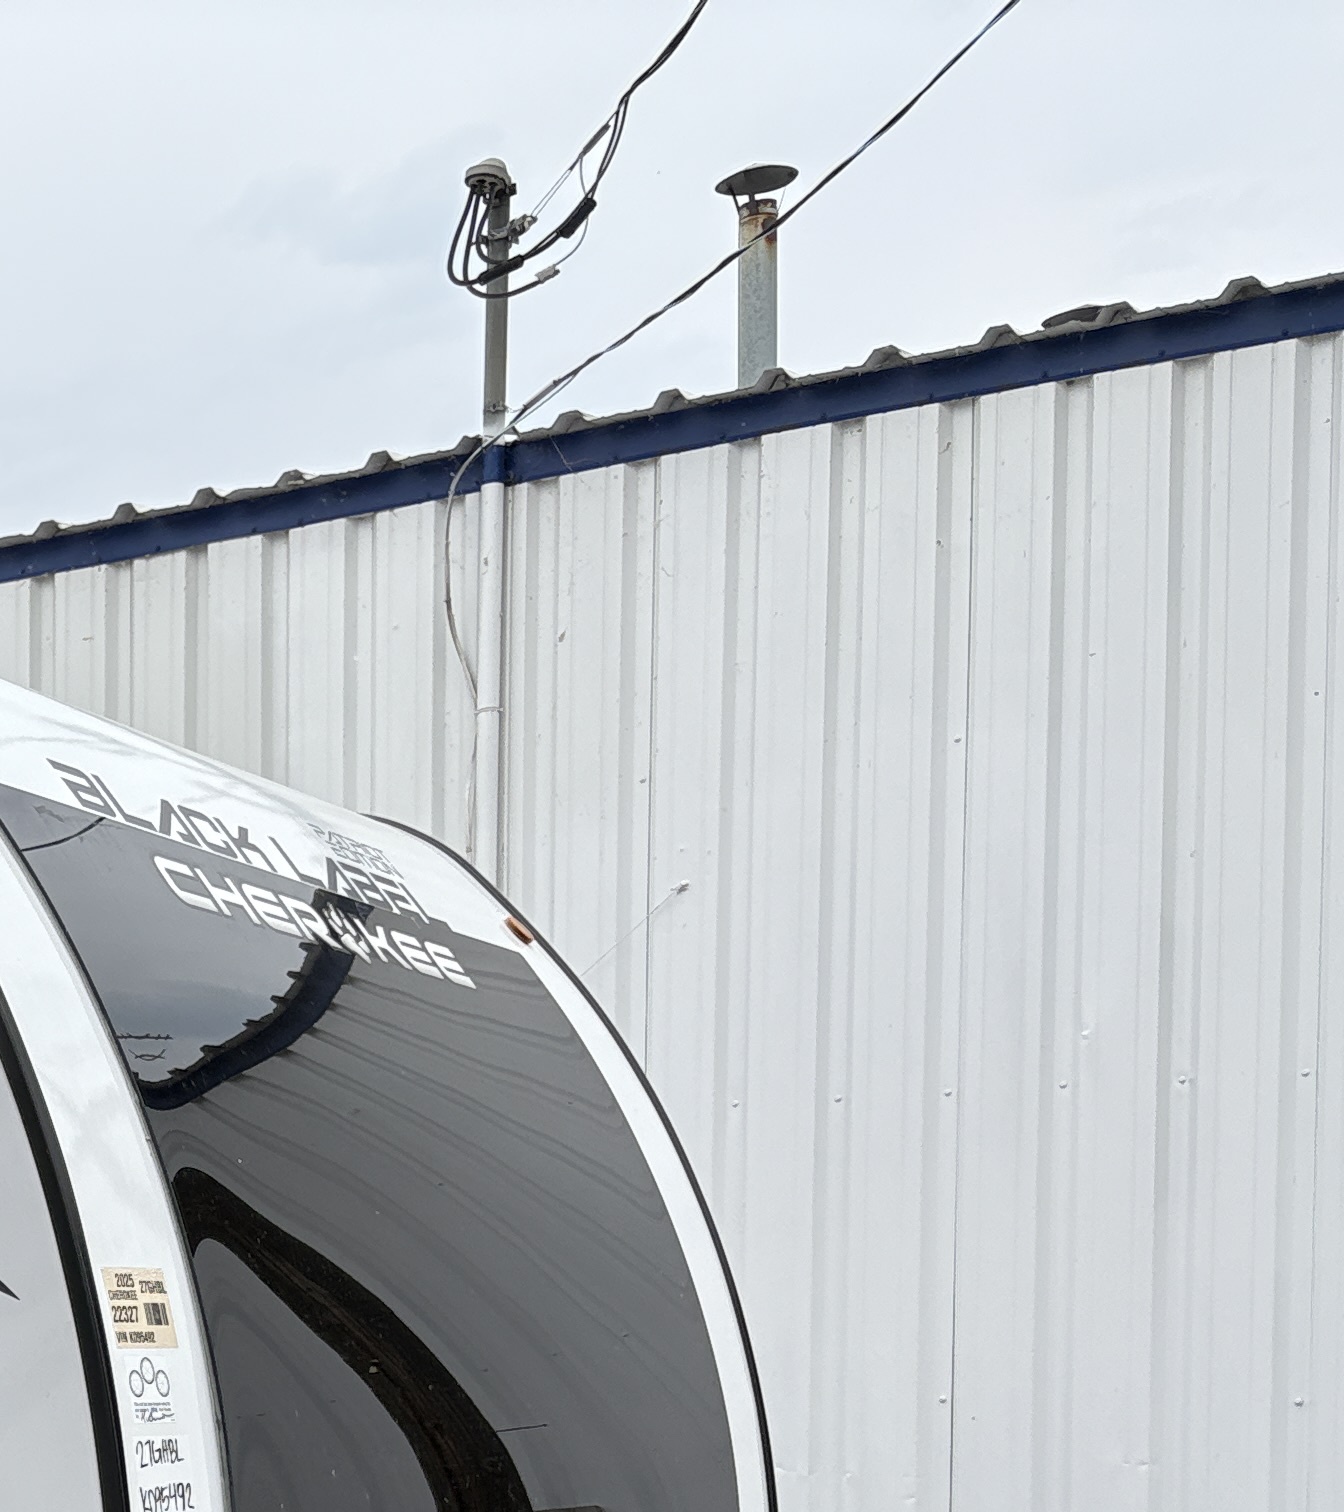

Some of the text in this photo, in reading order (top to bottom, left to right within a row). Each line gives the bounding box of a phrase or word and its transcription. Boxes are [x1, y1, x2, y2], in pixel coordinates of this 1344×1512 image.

[44, 757, 431, 926] BLACK LABEL
[114, 1272, 135, 1288] 2025
[111, 1305, 139, 1323] 22327
